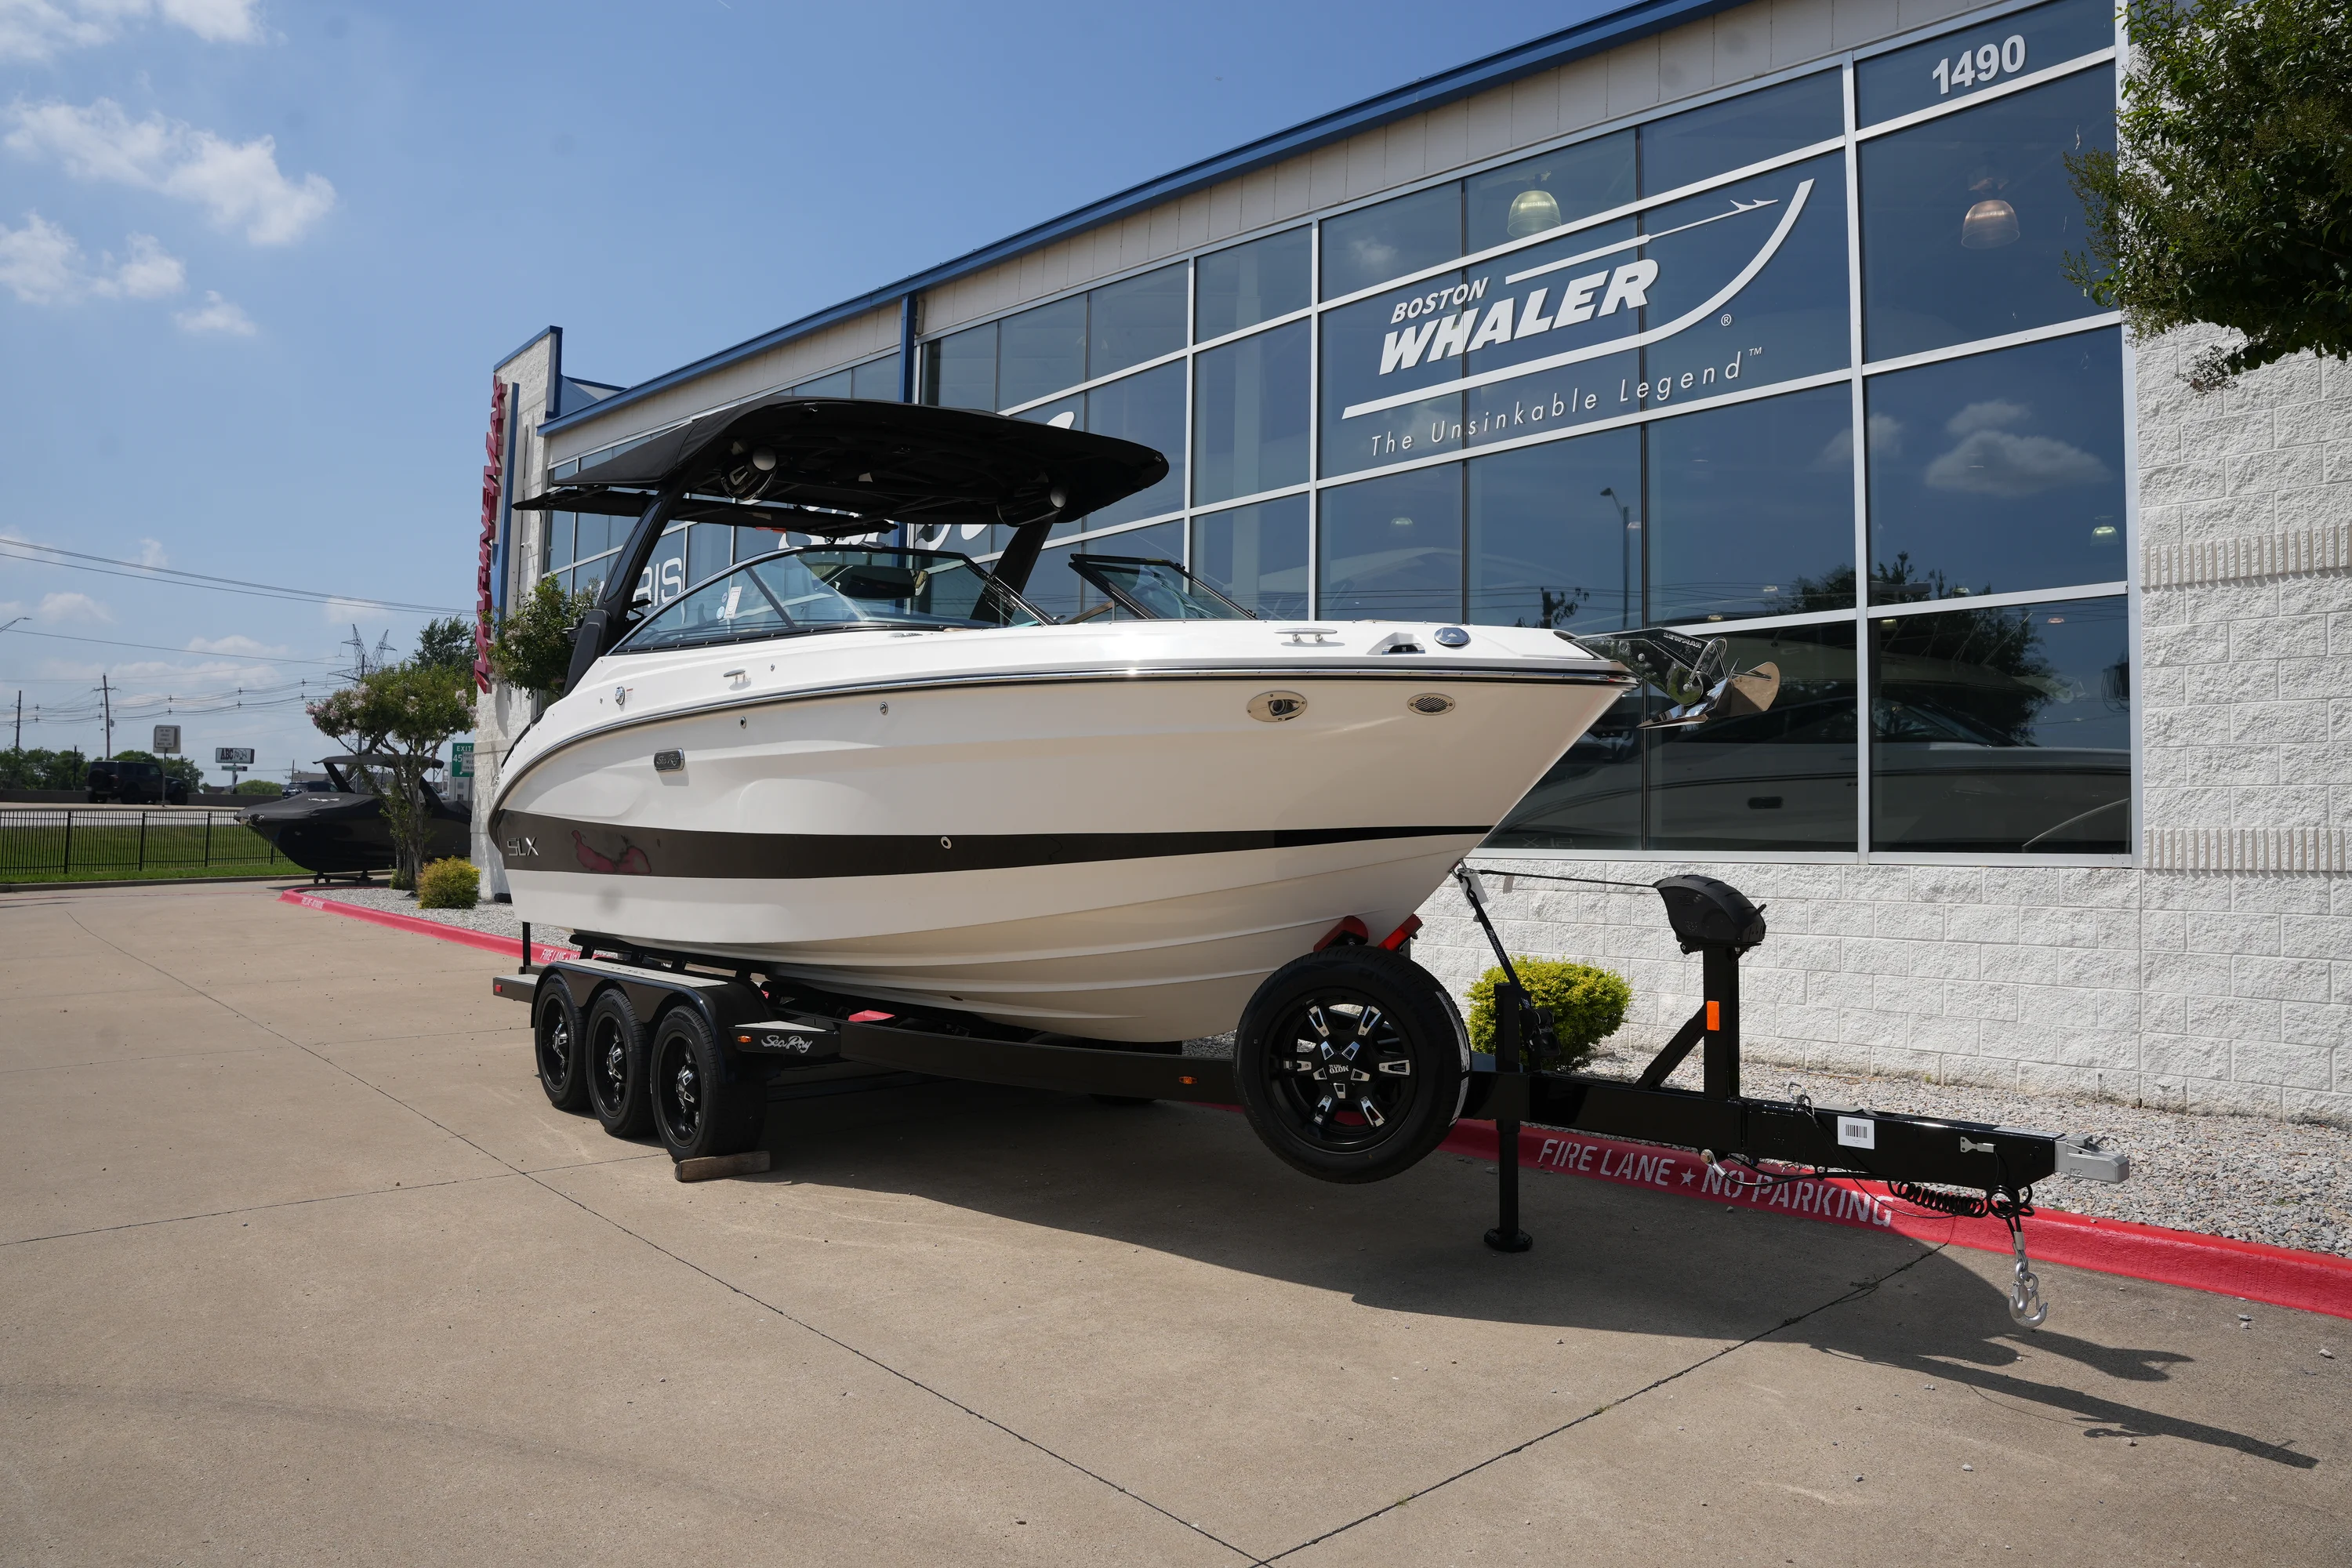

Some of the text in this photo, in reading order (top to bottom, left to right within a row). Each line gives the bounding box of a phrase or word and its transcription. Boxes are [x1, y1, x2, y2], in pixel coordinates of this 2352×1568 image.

[1933, 34, 2026, 95] 1490
[1390, 277, 1489, 323] BOSTON
[1379, 259, 1659, 375] WHALER
[1371, 430, 1414, 456] The
[1432, 387, 1599, 444] Unsinkable
[1620, 351, 1741, 401] Legend
[220, 748, 234, 760] ABC
[452, 754, 463, 763] 45
[507, 837, 539, 856] SLX
[540, 949, 554, 961] FIRE
[551, 950, 566, 962] LANE
[761, 1035, 813, 1054] Sea Ray
[1329, 1065, 1349, 1074] MOTO
[1537, 1138, 1895, 1228] FIRE LANE NO PARKING
